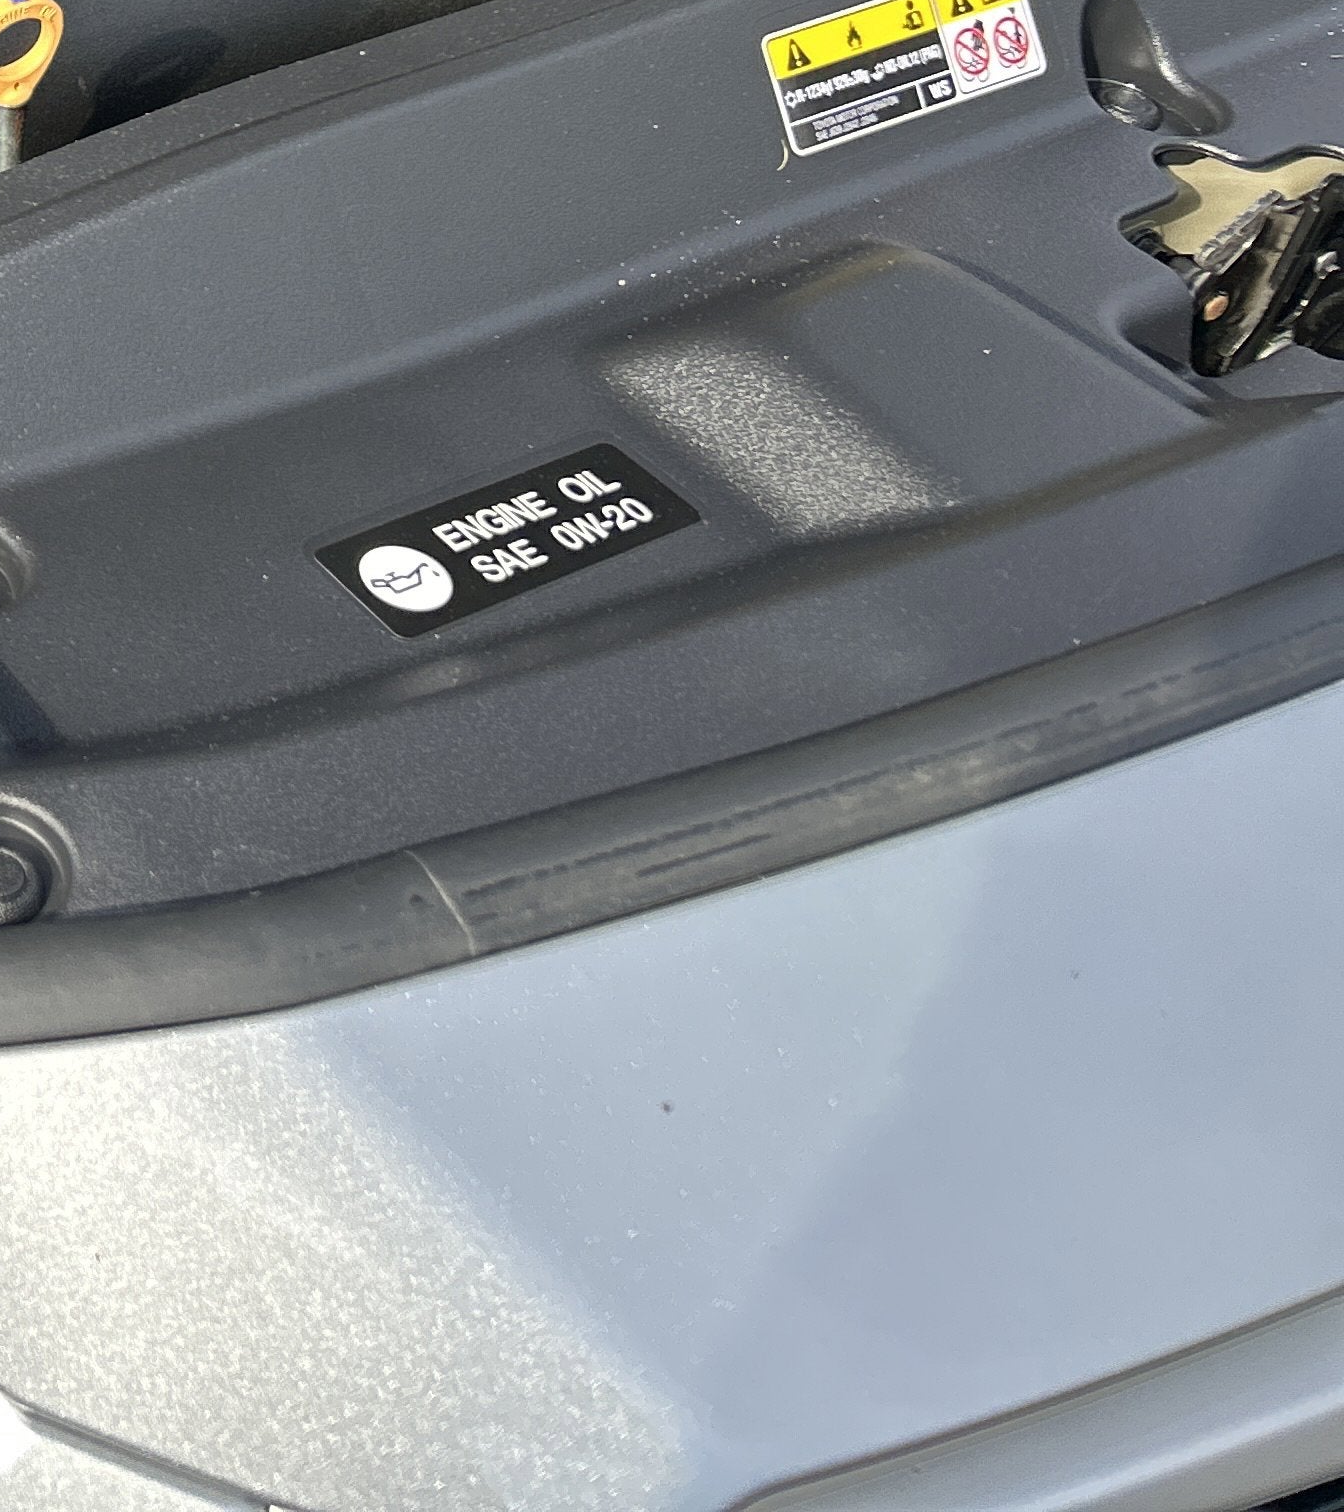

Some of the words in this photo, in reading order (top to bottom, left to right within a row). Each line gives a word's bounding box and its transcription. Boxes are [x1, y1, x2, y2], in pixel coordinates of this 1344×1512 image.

[431, 490, 558, 553] ENGINE
[557, 469, 622, 504] OIL
[469, 538, 549, 584] SAE
[550, 496, 655, 552] 0W-20
